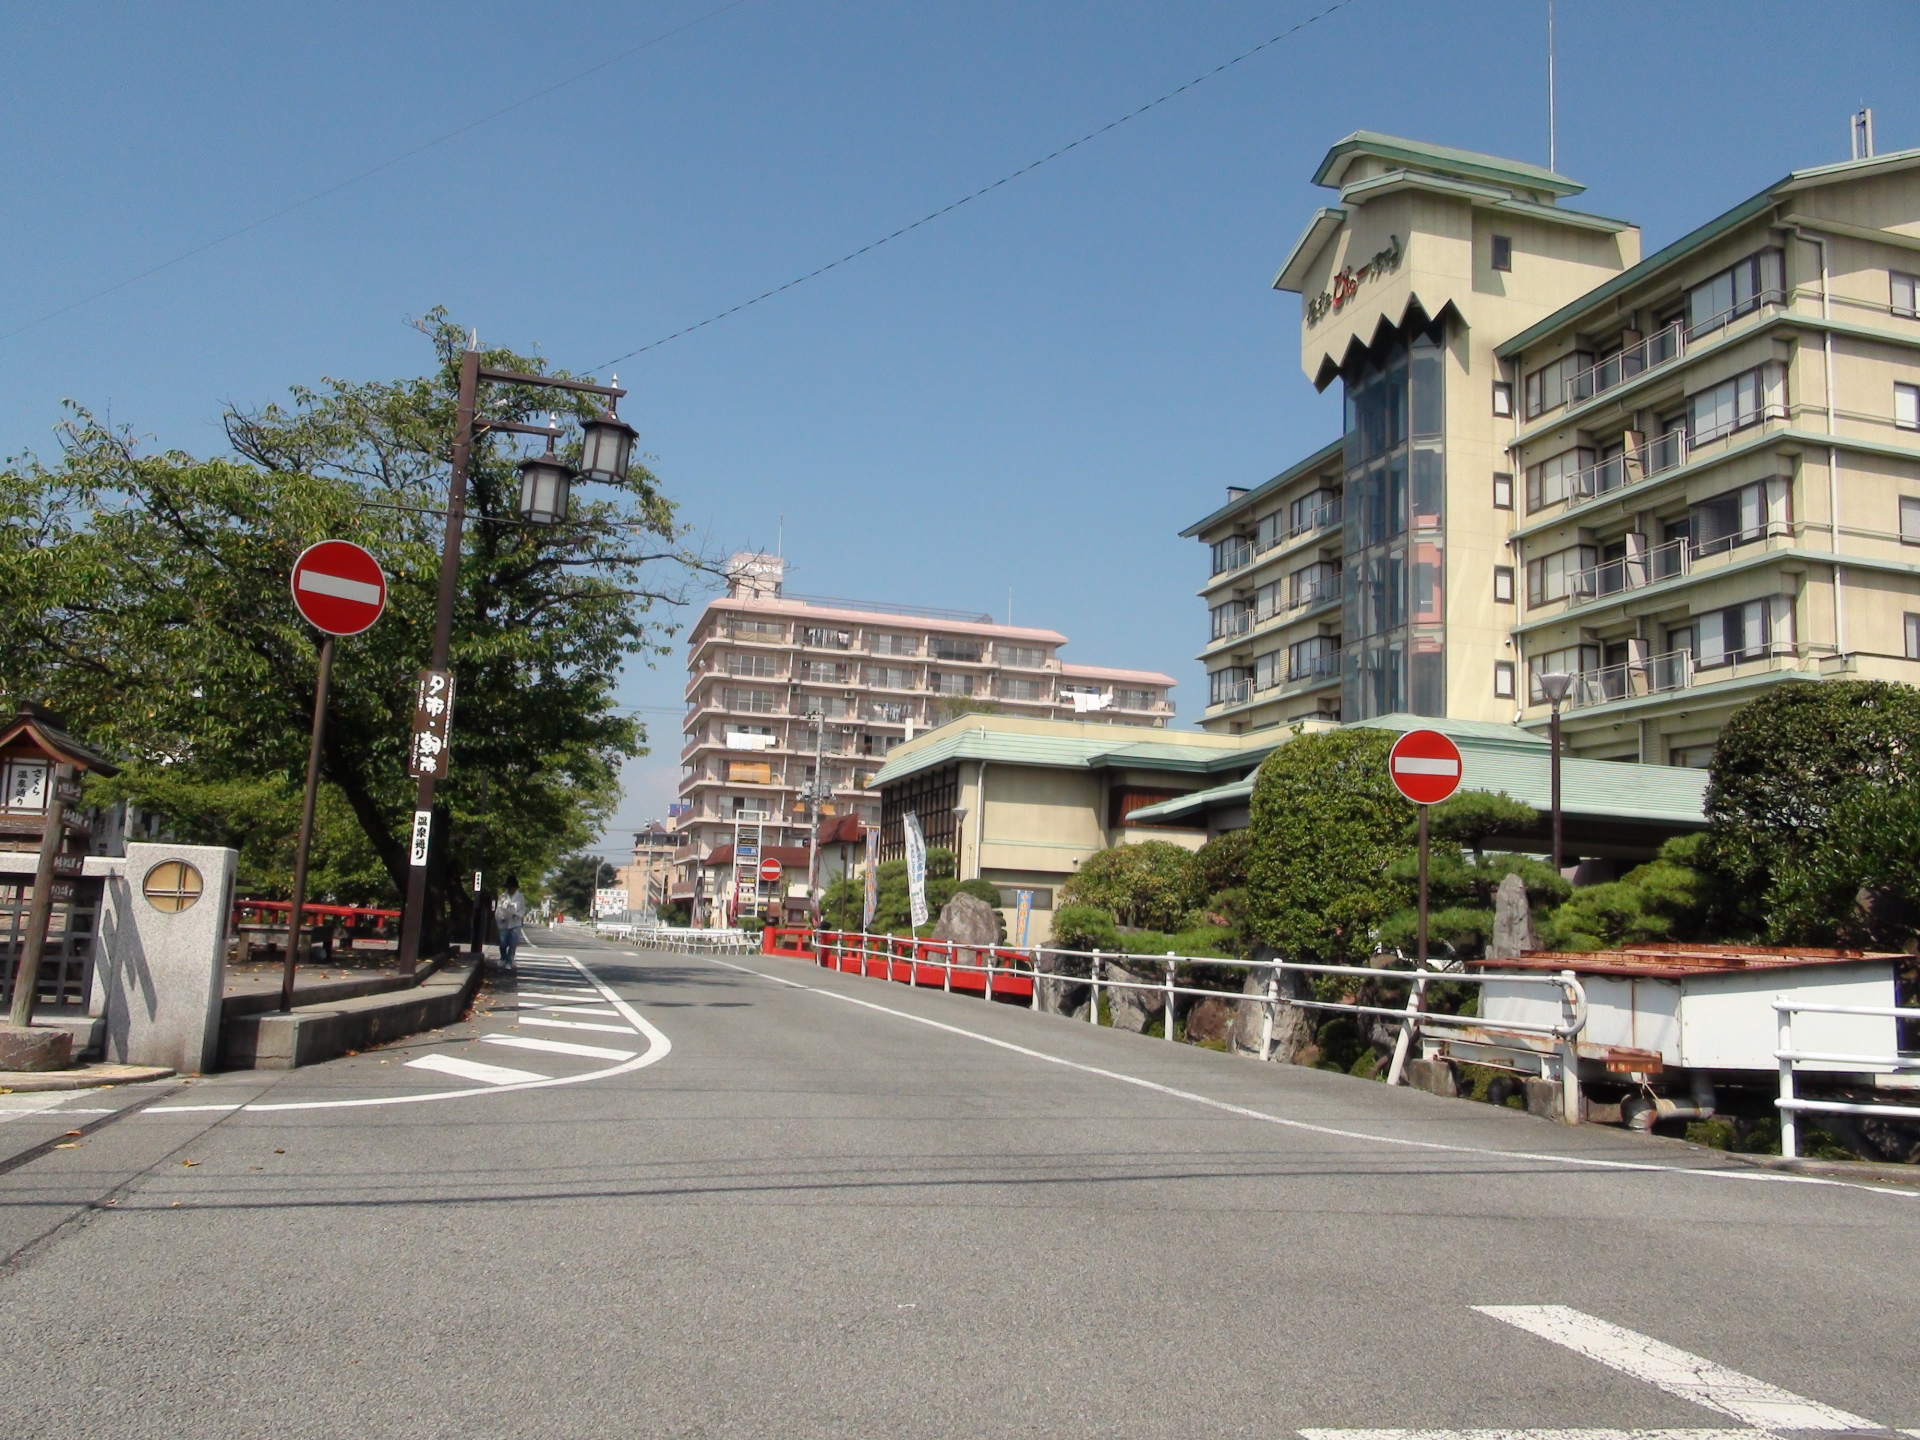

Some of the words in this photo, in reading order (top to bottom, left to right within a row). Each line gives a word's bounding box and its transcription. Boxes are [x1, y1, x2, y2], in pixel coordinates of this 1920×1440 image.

[419, 675, 445, 774] 夕市・朝市
[15, 770, 29, 806] 温泉通り
[32, 768, 43, 796] さくら
[415, 816, 427, 860] 温泉通り
